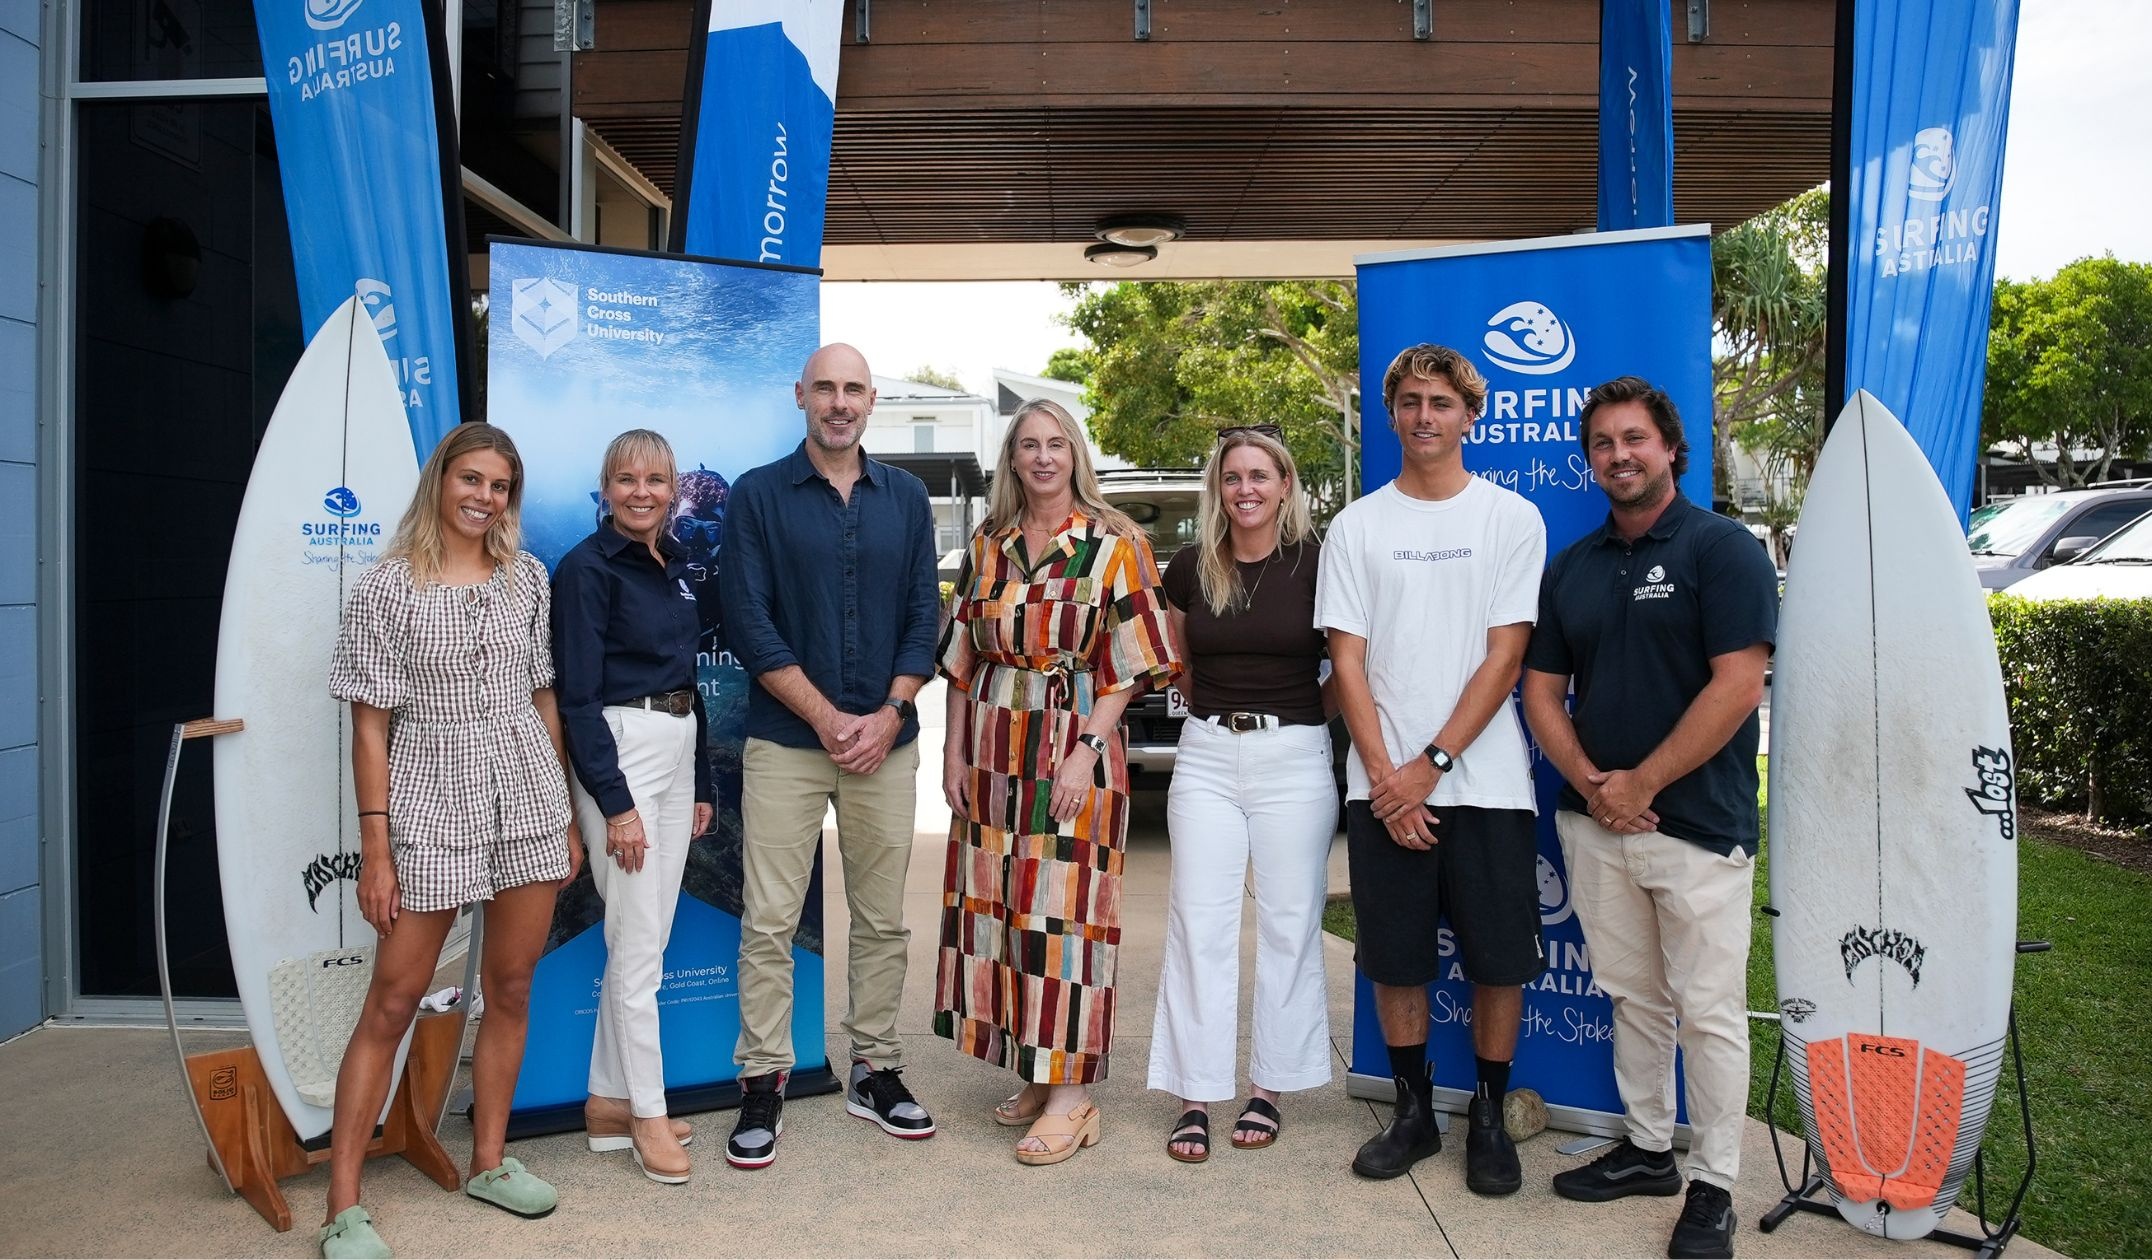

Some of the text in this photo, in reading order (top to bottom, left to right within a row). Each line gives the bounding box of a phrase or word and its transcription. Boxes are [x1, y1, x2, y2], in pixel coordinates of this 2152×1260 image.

[587, 287, 658, 307] Southern
[587, 305, 632, 322] Cross
[587, 324, 664, 345] University
[1461, 421, 1577, 444] USTRAL
[1524, 457, 1561, 492] the
[302, 523, 381, 536] SURFING
[309, 537, 374, 546] AUSTRALIA
[1393, 548, 1472, 561] BILLABONG
[1633, 583, 1675, 597] SURFING
[1635, 592, 1670, 602] AUSTRALIA
[323, 955, 364, 969] FCS
[676, 965, 728, 979] University
[669, 981, 686, 989] Gold
[708, 976, 730, 985] Online
[1520, 1004, 1555, 1038] the
[1861, 1043, 1905, 1058] FCS
